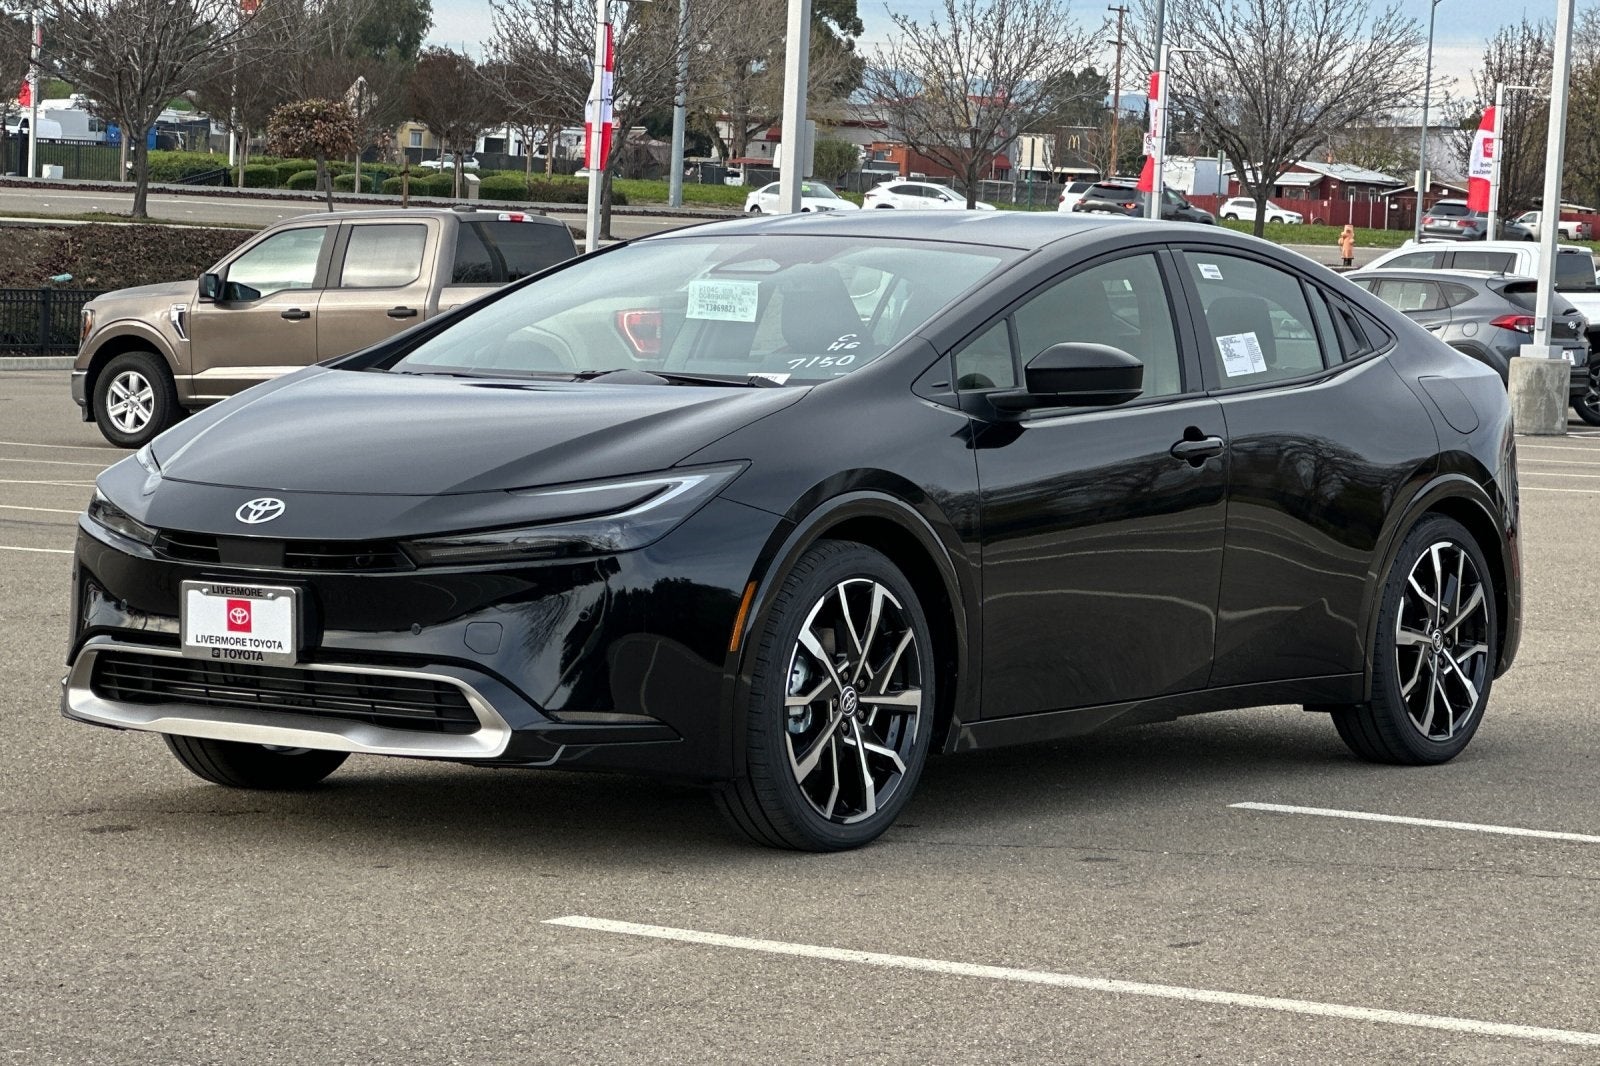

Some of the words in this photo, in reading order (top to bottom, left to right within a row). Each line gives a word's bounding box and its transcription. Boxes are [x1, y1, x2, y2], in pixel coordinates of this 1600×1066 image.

[787, 354, 856, 370] 7150
[212, 585, 263, 597] LIVERMORE
[195, 634, 247, 647] LIVERMORE
[248, 638, 283, 650] TOYOTA
[223, 648, 264, 661] TOYOTA
